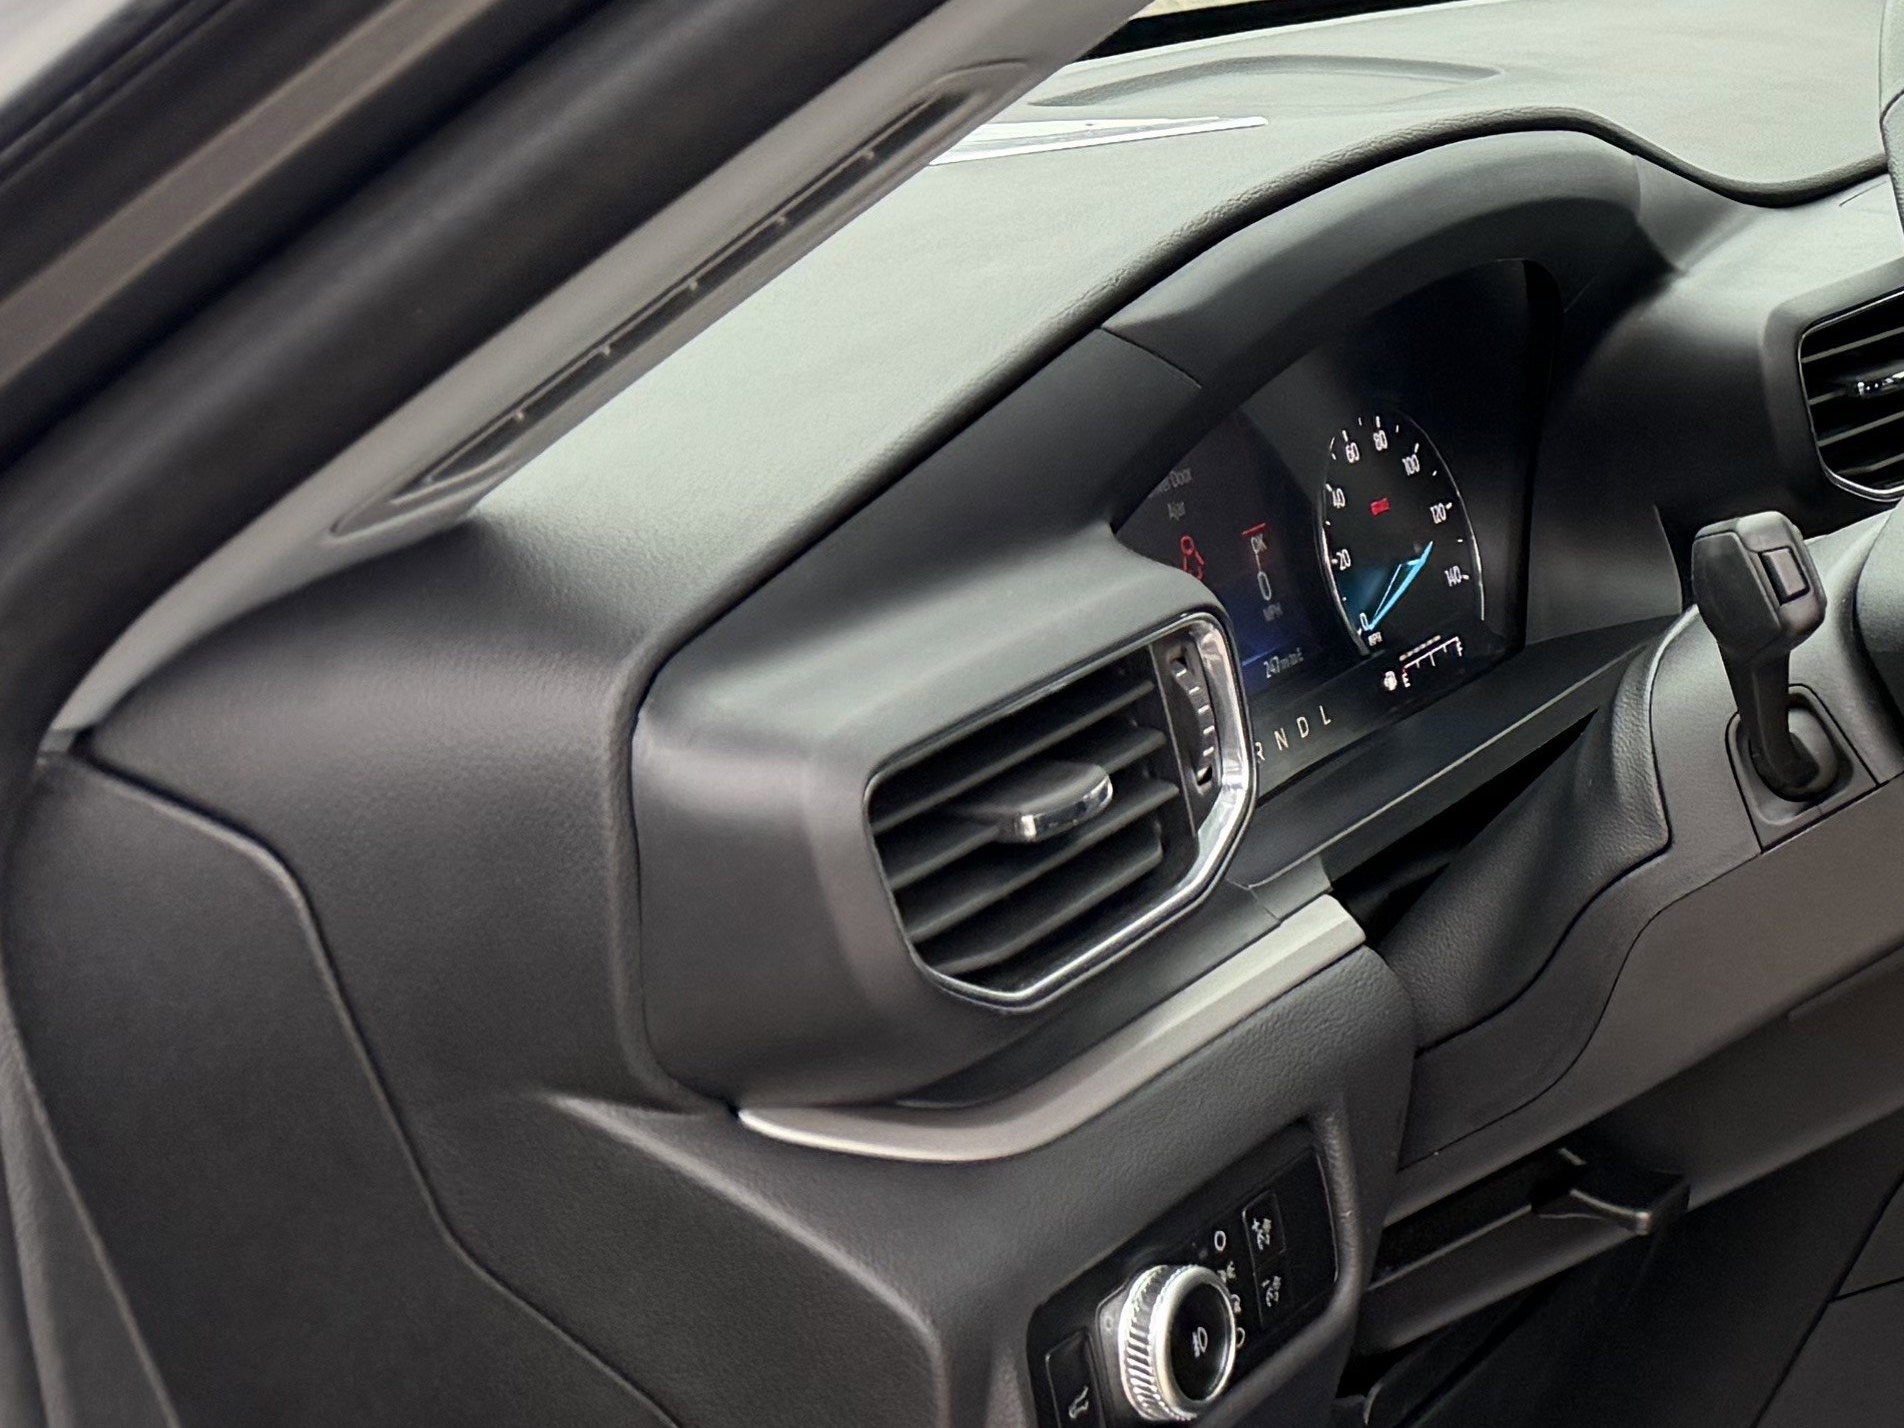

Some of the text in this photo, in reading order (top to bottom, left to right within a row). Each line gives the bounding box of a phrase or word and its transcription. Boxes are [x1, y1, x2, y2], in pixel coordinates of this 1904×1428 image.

[1373, 429, 1388, 452] 80
[1345, 442, 1360, 464] 60
[1402, 453, 1420, 476] 100
[1332, 488, 1346, 509] 40
[1430, 502, 1447, 524] 120
[1336, 548, 1352, 571] 20
[1444, 565, 1463, 587] 140
[1402, 671, 1411, 688] E
[1273, 727, 1289, 751] N
[1296, 716, 1310, 739] D
[1319, 705, 1332, 726] L
